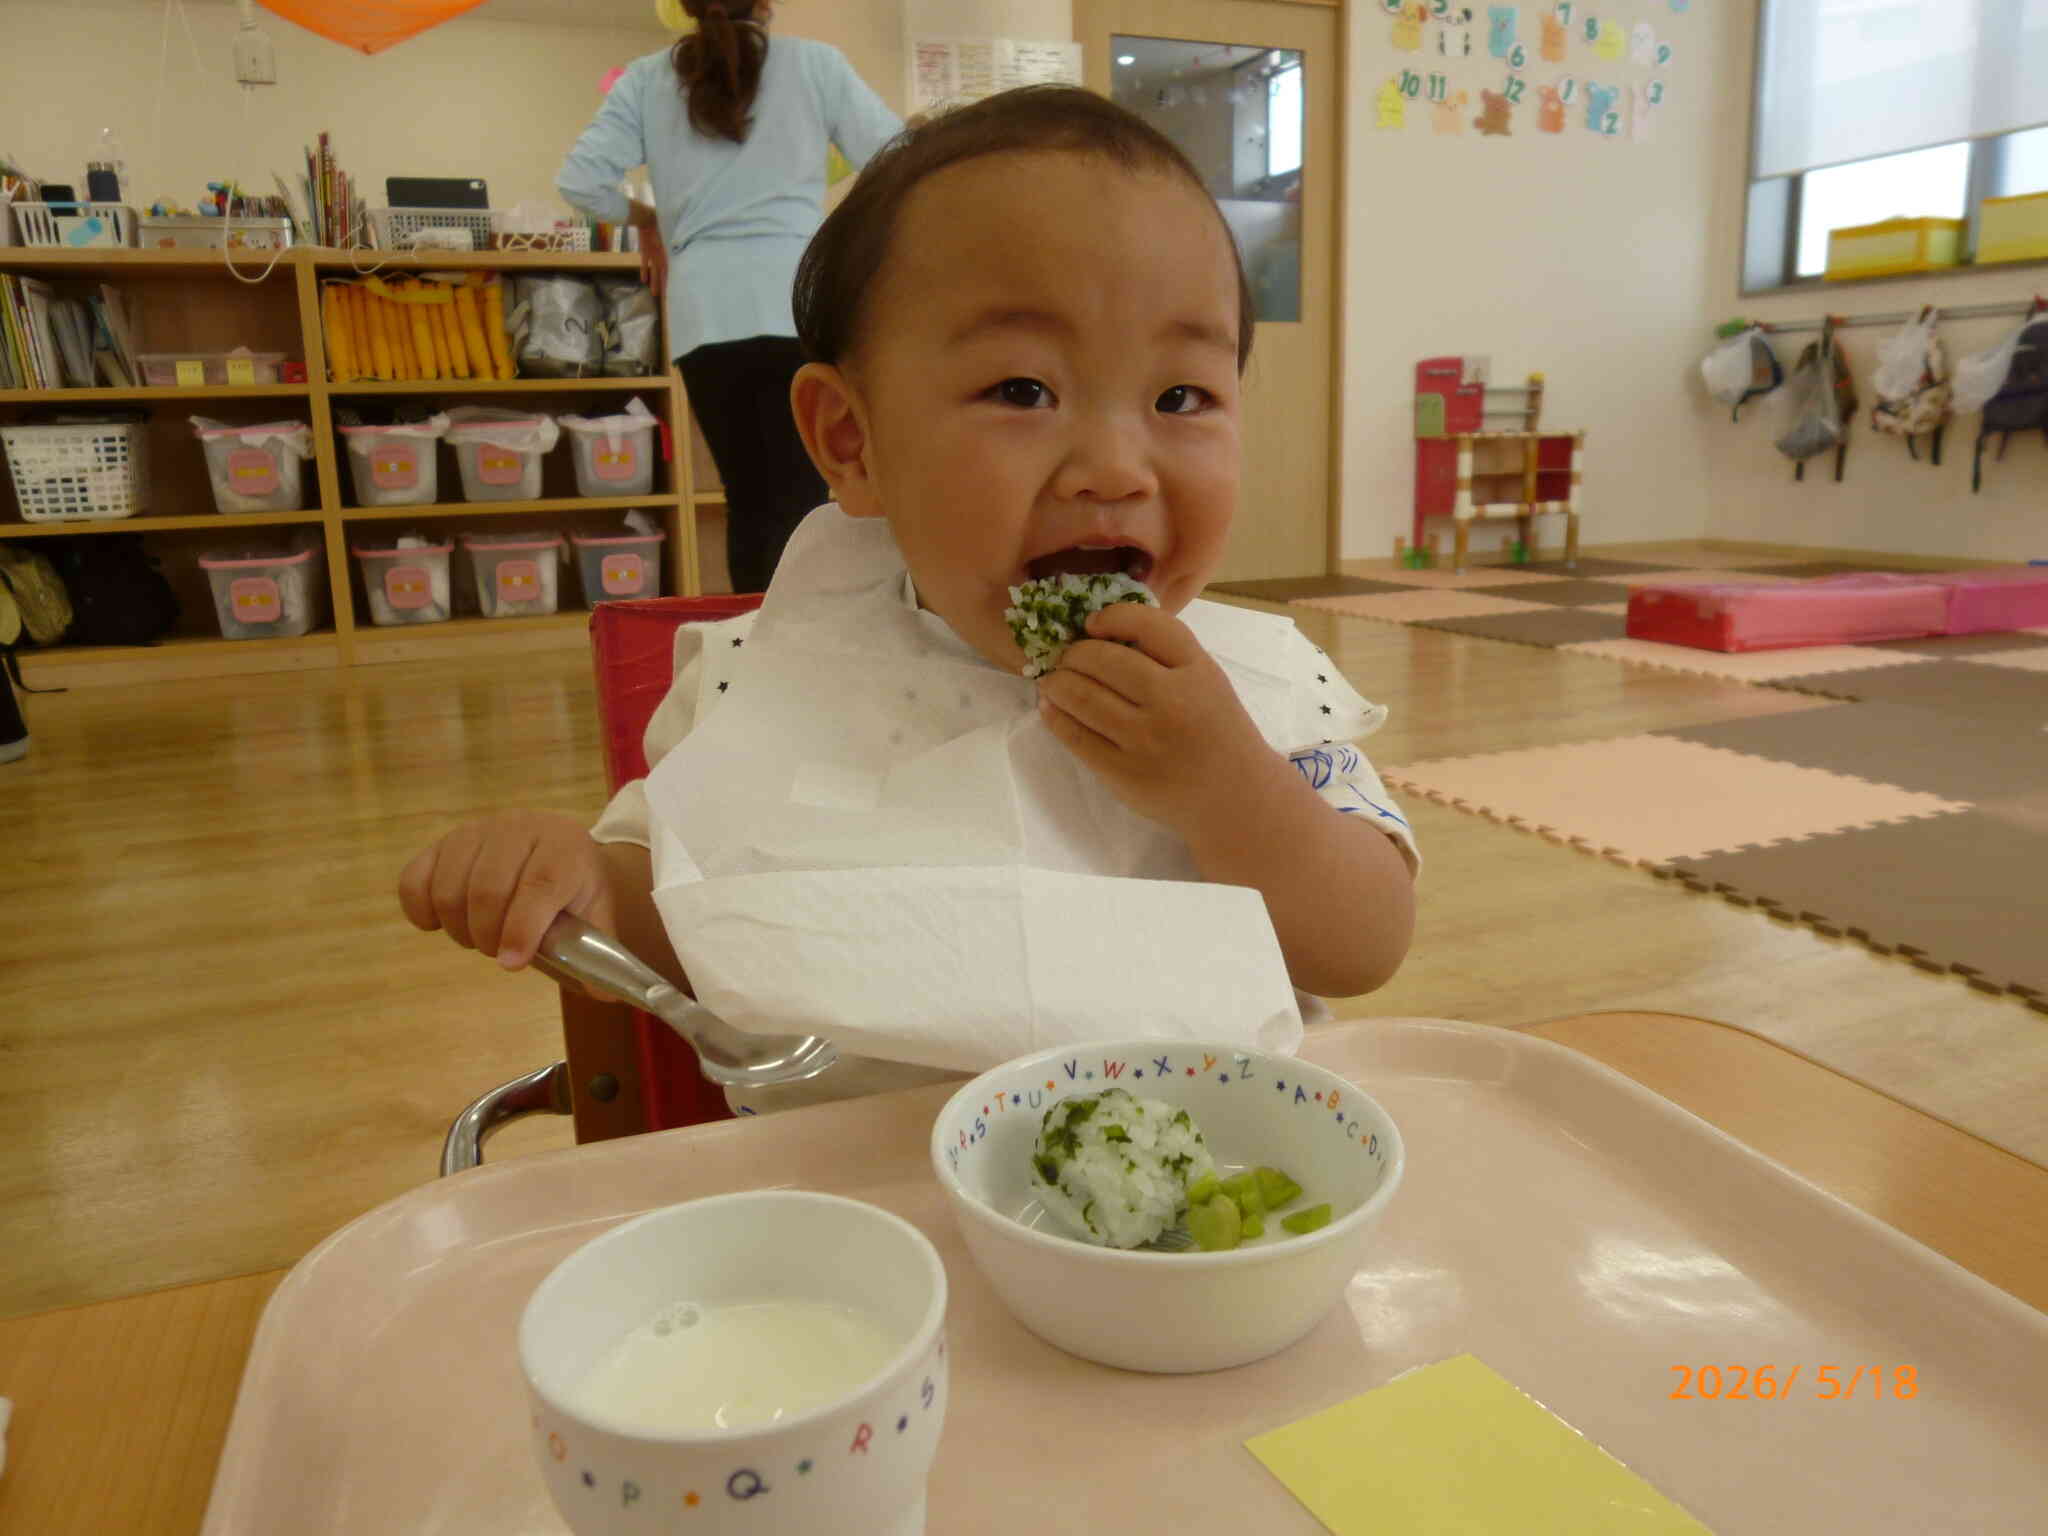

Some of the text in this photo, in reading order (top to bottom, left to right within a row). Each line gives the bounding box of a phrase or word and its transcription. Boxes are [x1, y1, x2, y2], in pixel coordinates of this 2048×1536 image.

[1557, 2, 1571, 25] 7
[1585, 17, 1598, 40] 8
[1510, 45, 1671, 67] 6 9
[1399, 71, 1420, 97] 10
[1428, 74, 1446, 100] 11
[1504, 75, 1525, 102] 12
[1562, 79, 1574, 101] 1
[1606, 112, 1619, 134] 2
[995, 1091, 1006, 1112] T
[1028, 1089, 1042, 1109] U
[1064, 1059, 1077, 1081] V
[1104, 1060, 1126, 1080] W
[1153, 1055, 1173, 1077] X
[1234, 1054, 1254, 1080] Z
[1294, 1083, 1307, 1105] A
[1327, 1089, 1341, 1109] B
[1346, 1120, 1359, 1139] C
[622, 1479, 641, 1507] P
[725, 1468, 770, 1501] Q
[848, 1422, 873, 1454] R
